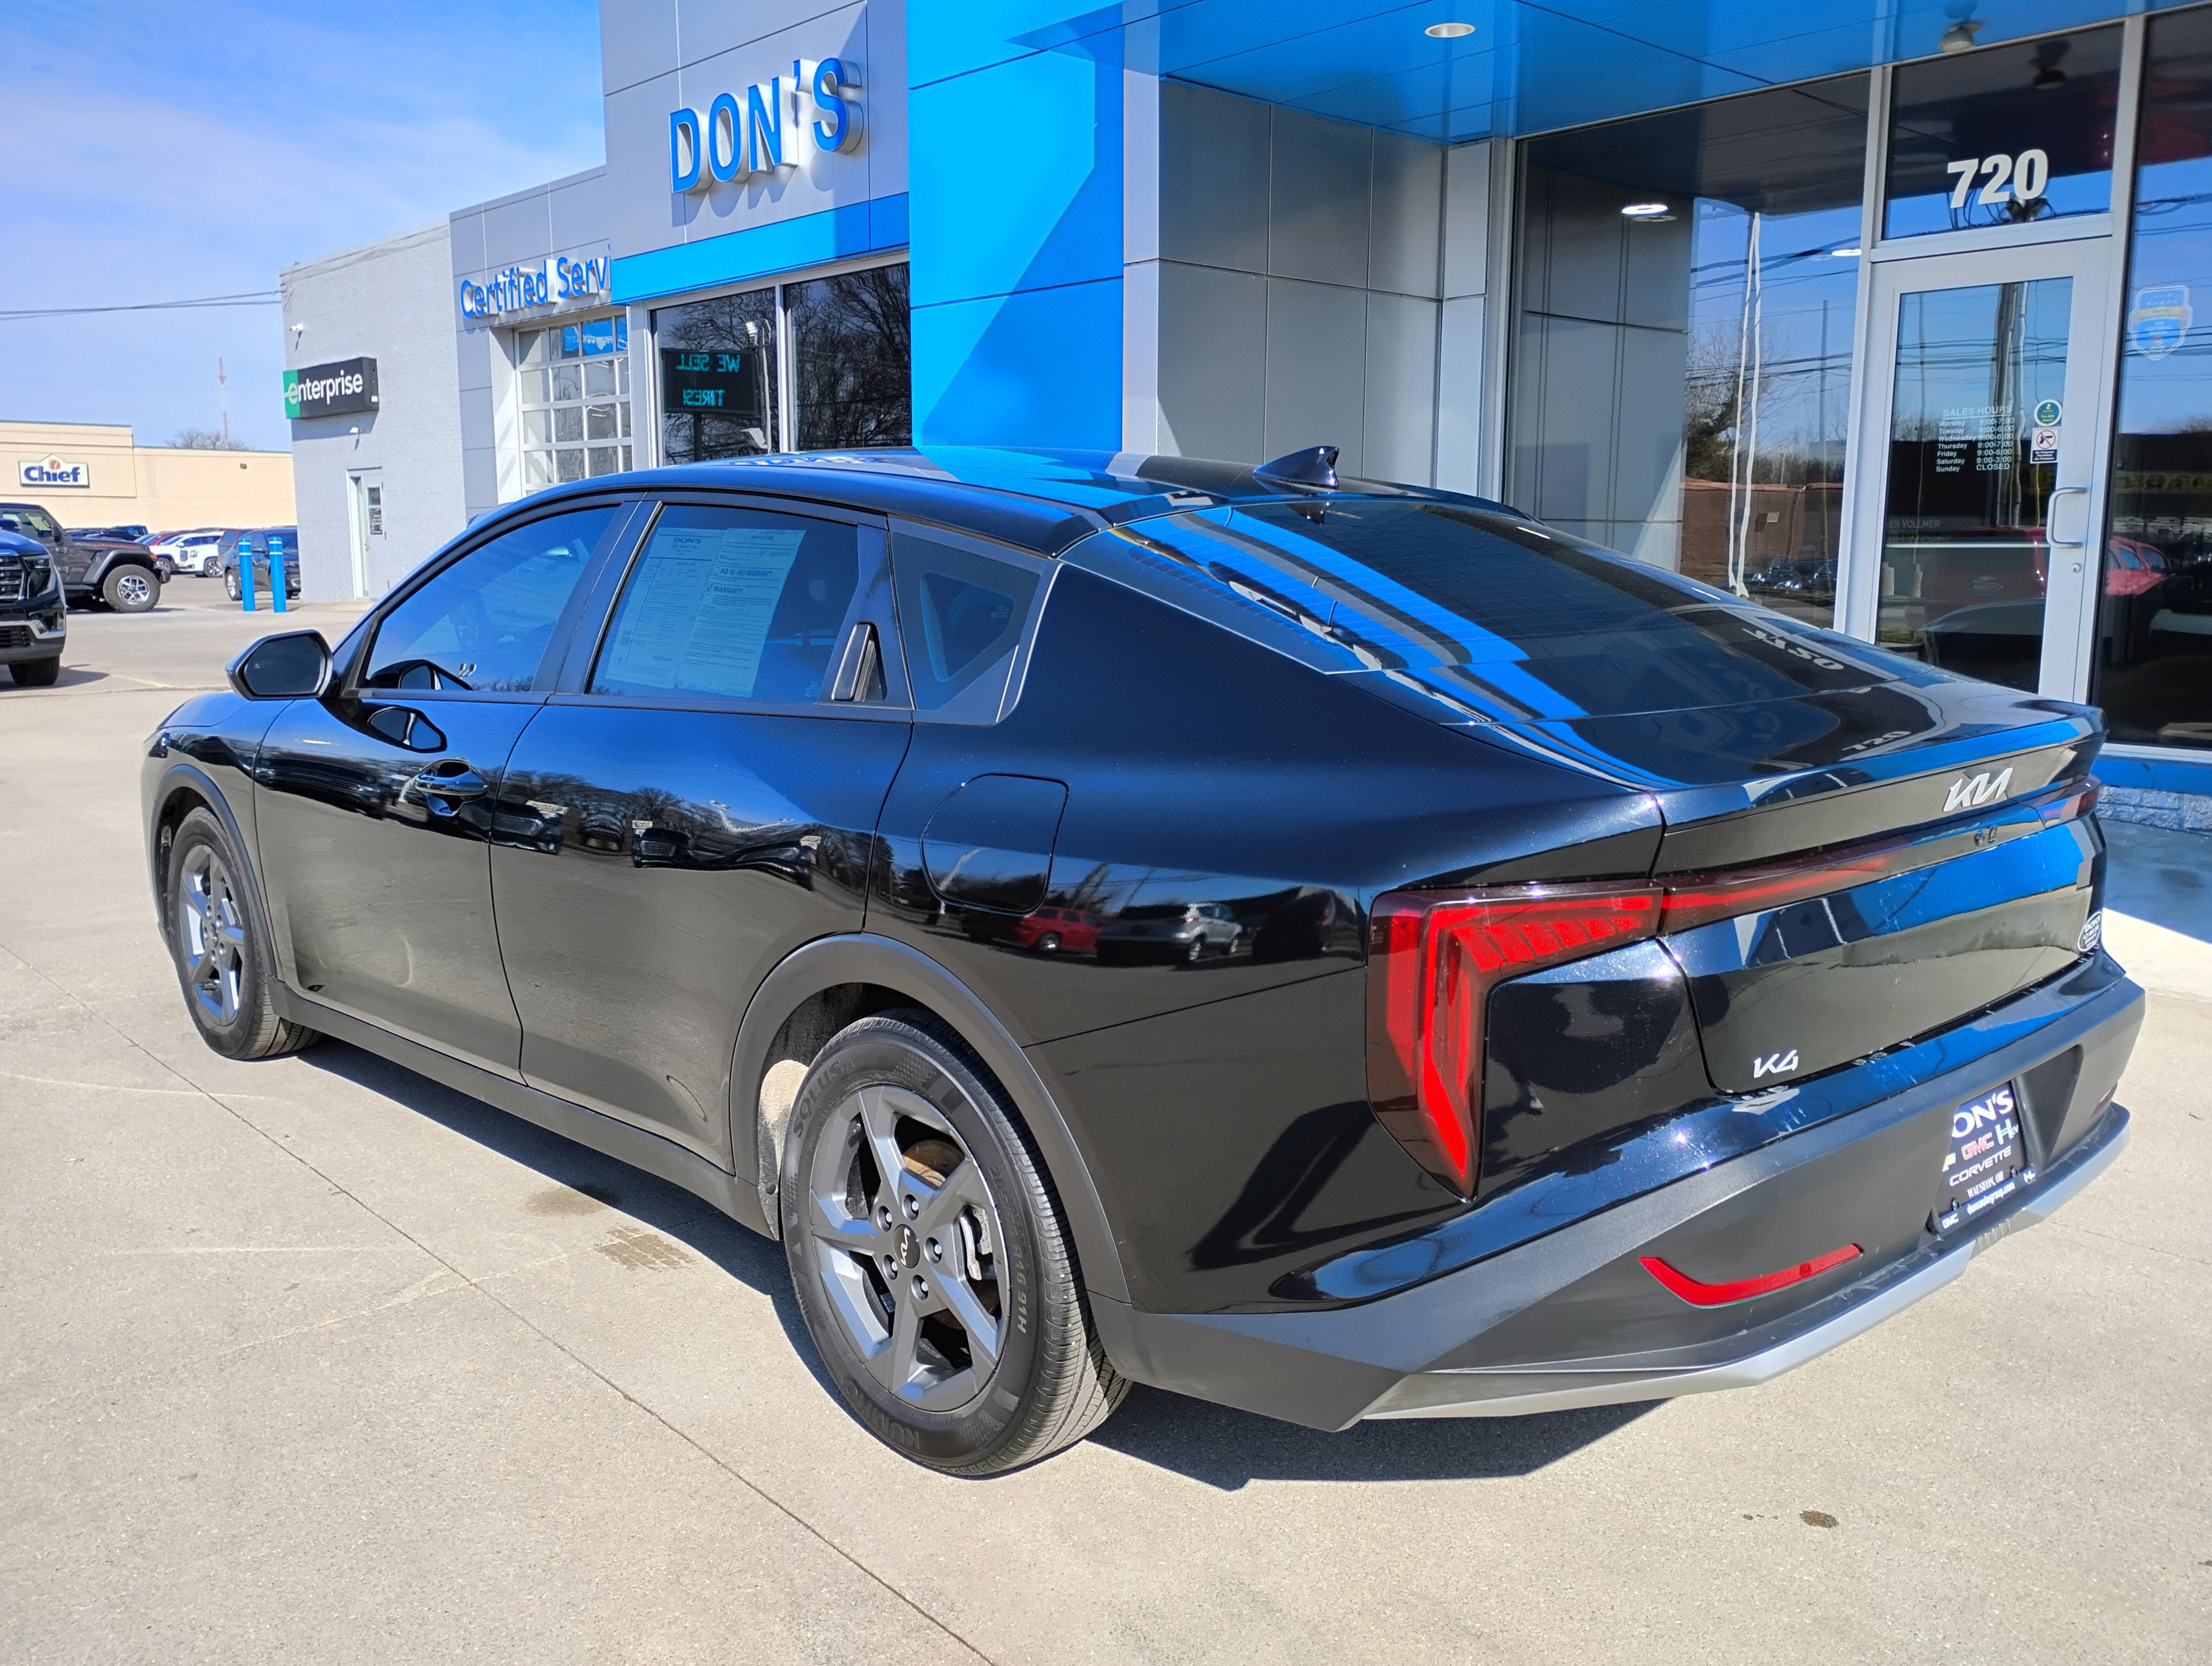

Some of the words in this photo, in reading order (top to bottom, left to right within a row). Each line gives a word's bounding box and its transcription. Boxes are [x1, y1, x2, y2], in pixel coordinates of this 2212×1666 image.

[669, 57, 854, 194] DON'S
[1947, 149, 2049, 209] 720
[460, 259, 548, 319] Certified
[284, 369, 363, 405] enterprise
[1943, 408, 1974, 417] SALES
[1977, 406, 2012, 414] HOURS
[24, 465, 80, 482] Chief
[1902, 518, 1940, 529] VOLLMER
[713, 585, 743, 594] WARRANTY
[1943, 767, 2013, 812] KIA
[1753, 1049, 1799, 1078] K4
[794, 1060, 843, 1138] SOLUS
[1961, 1132, 1995, 1160] GMC
[1949, 1145, 2011, 1187] CORVETTE
[1995, 1170, 2004, 1183] OH
[1966, 1181, 2016, 1215] donsautogroup.com
[1942, 1213, 1959, 1229] GMC
[1017, 1295, 1027, 1334] 91H
